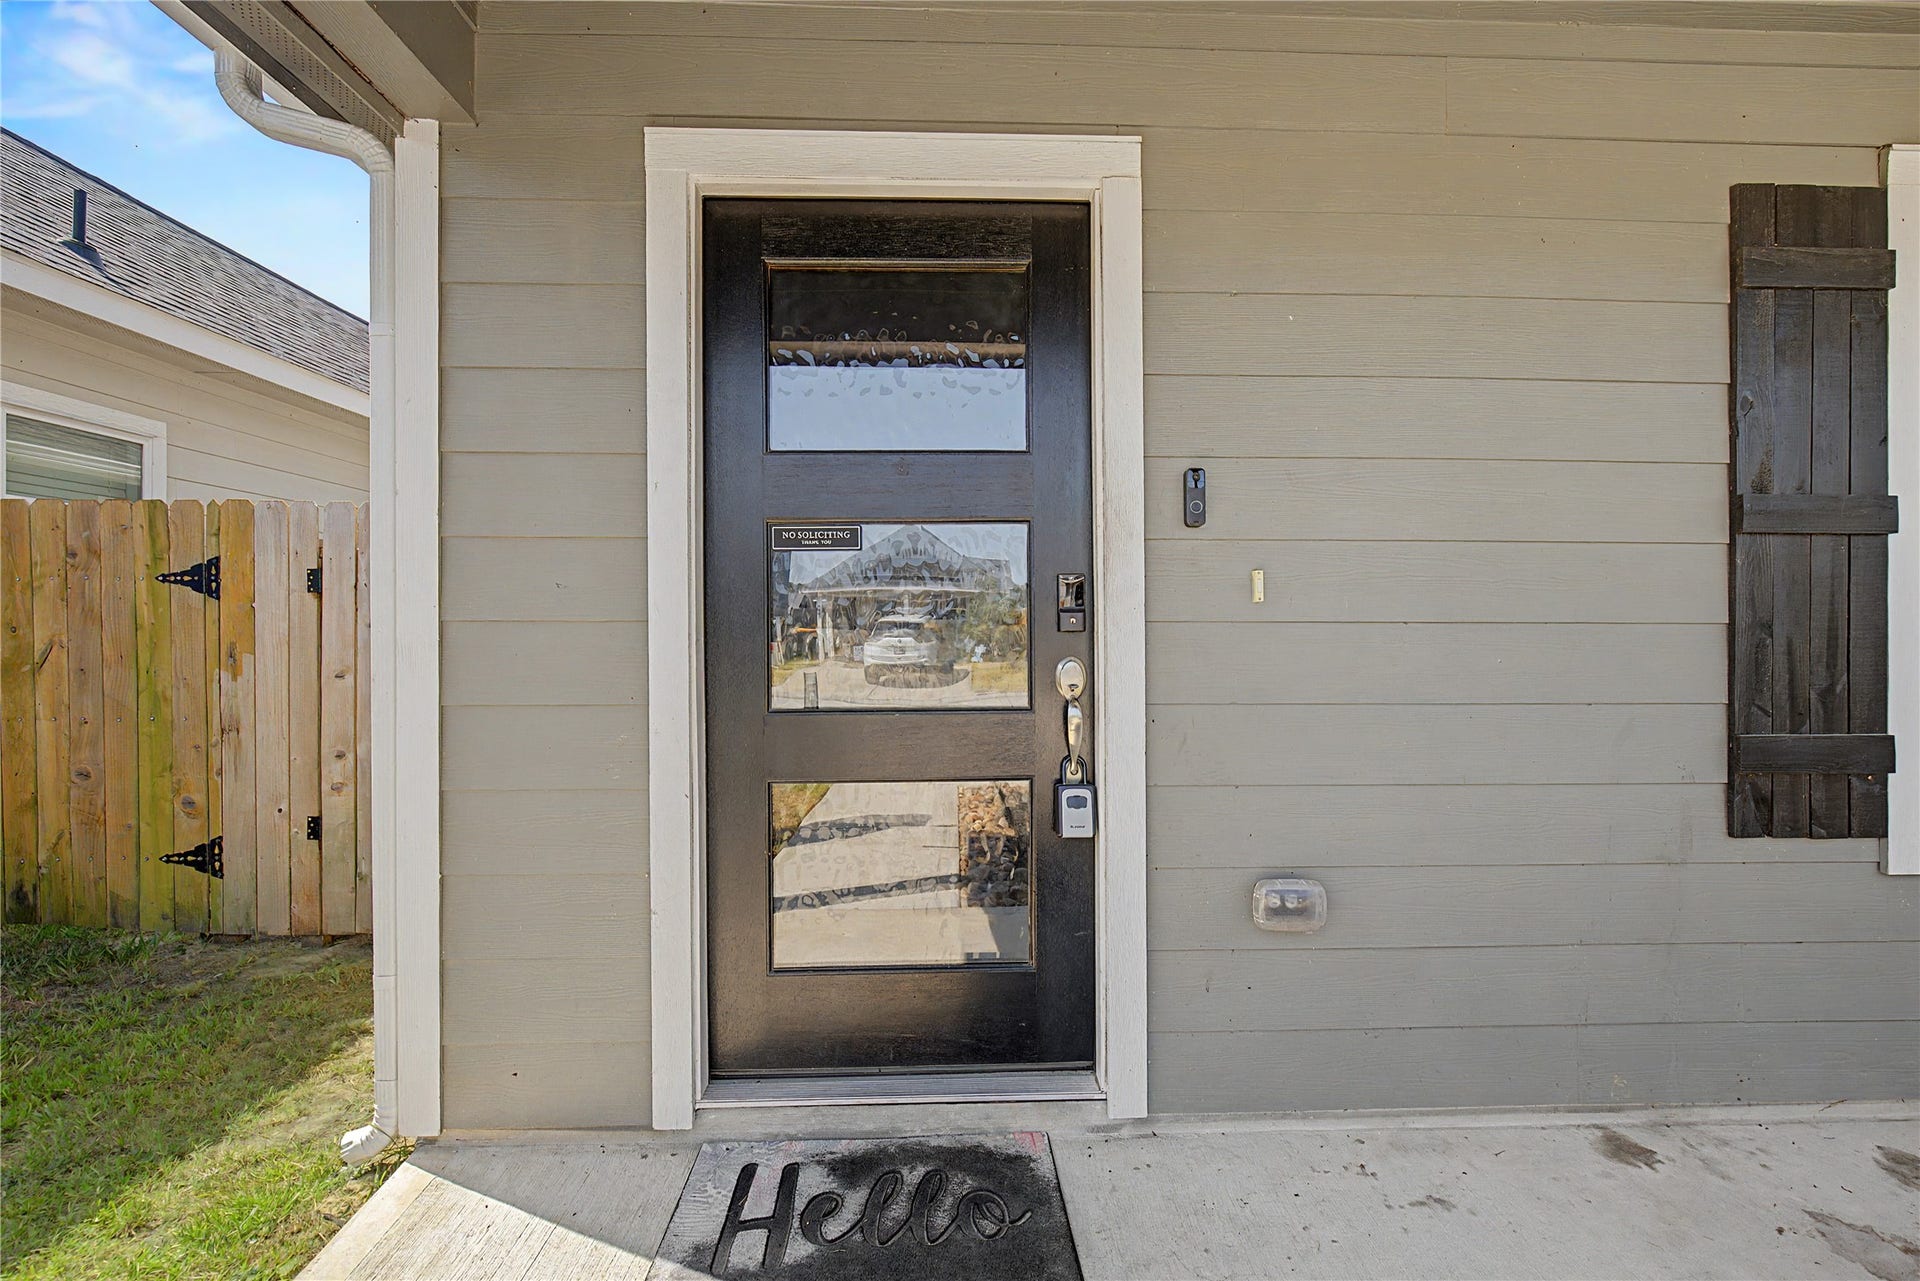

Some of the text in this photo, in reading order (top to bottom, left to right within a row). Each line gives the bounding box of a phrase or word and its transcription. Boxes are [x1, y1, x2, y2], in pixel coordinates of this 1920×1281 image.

[782, 530, 851, 539] NO SOLICITING
[709, 1162, 1033, 1275] Hello
